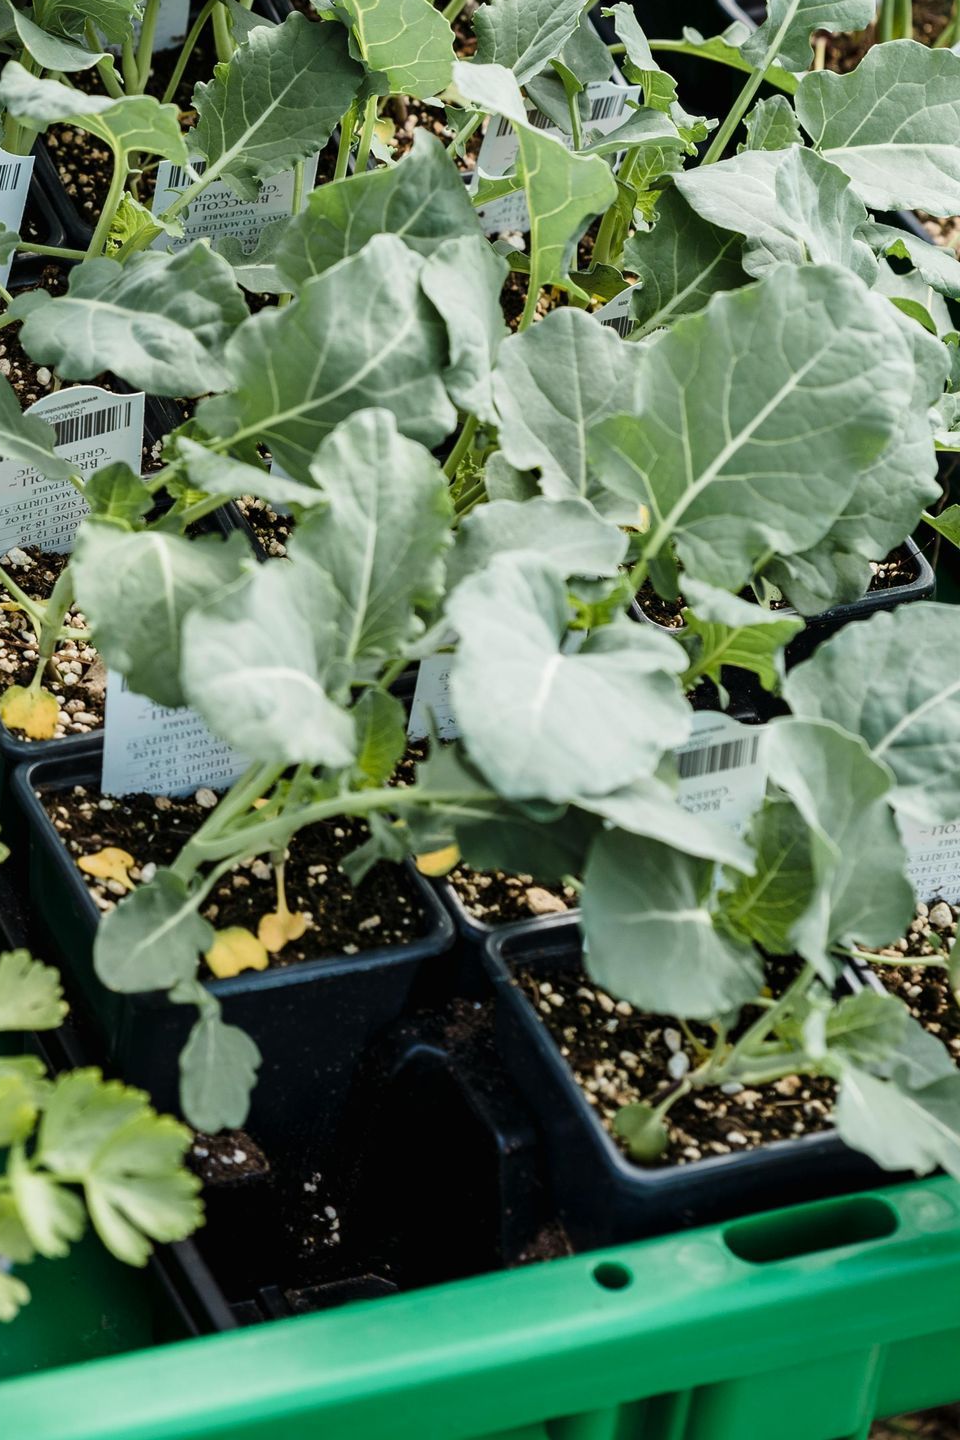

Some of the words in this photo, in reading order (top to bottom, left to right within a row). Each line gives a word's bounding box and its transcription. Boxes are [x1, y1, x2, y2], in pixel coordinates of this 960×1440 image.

[201, 208, 254, 221] VEGETABLE
[183, 221, 237, 234] MATURITY
[44, 406, 86, 423] JSM060
[12, 490, 71, 512] MATURITY:
[4, 516, 19, 524] OZ
[22, 508, 48, 520] 12-14
